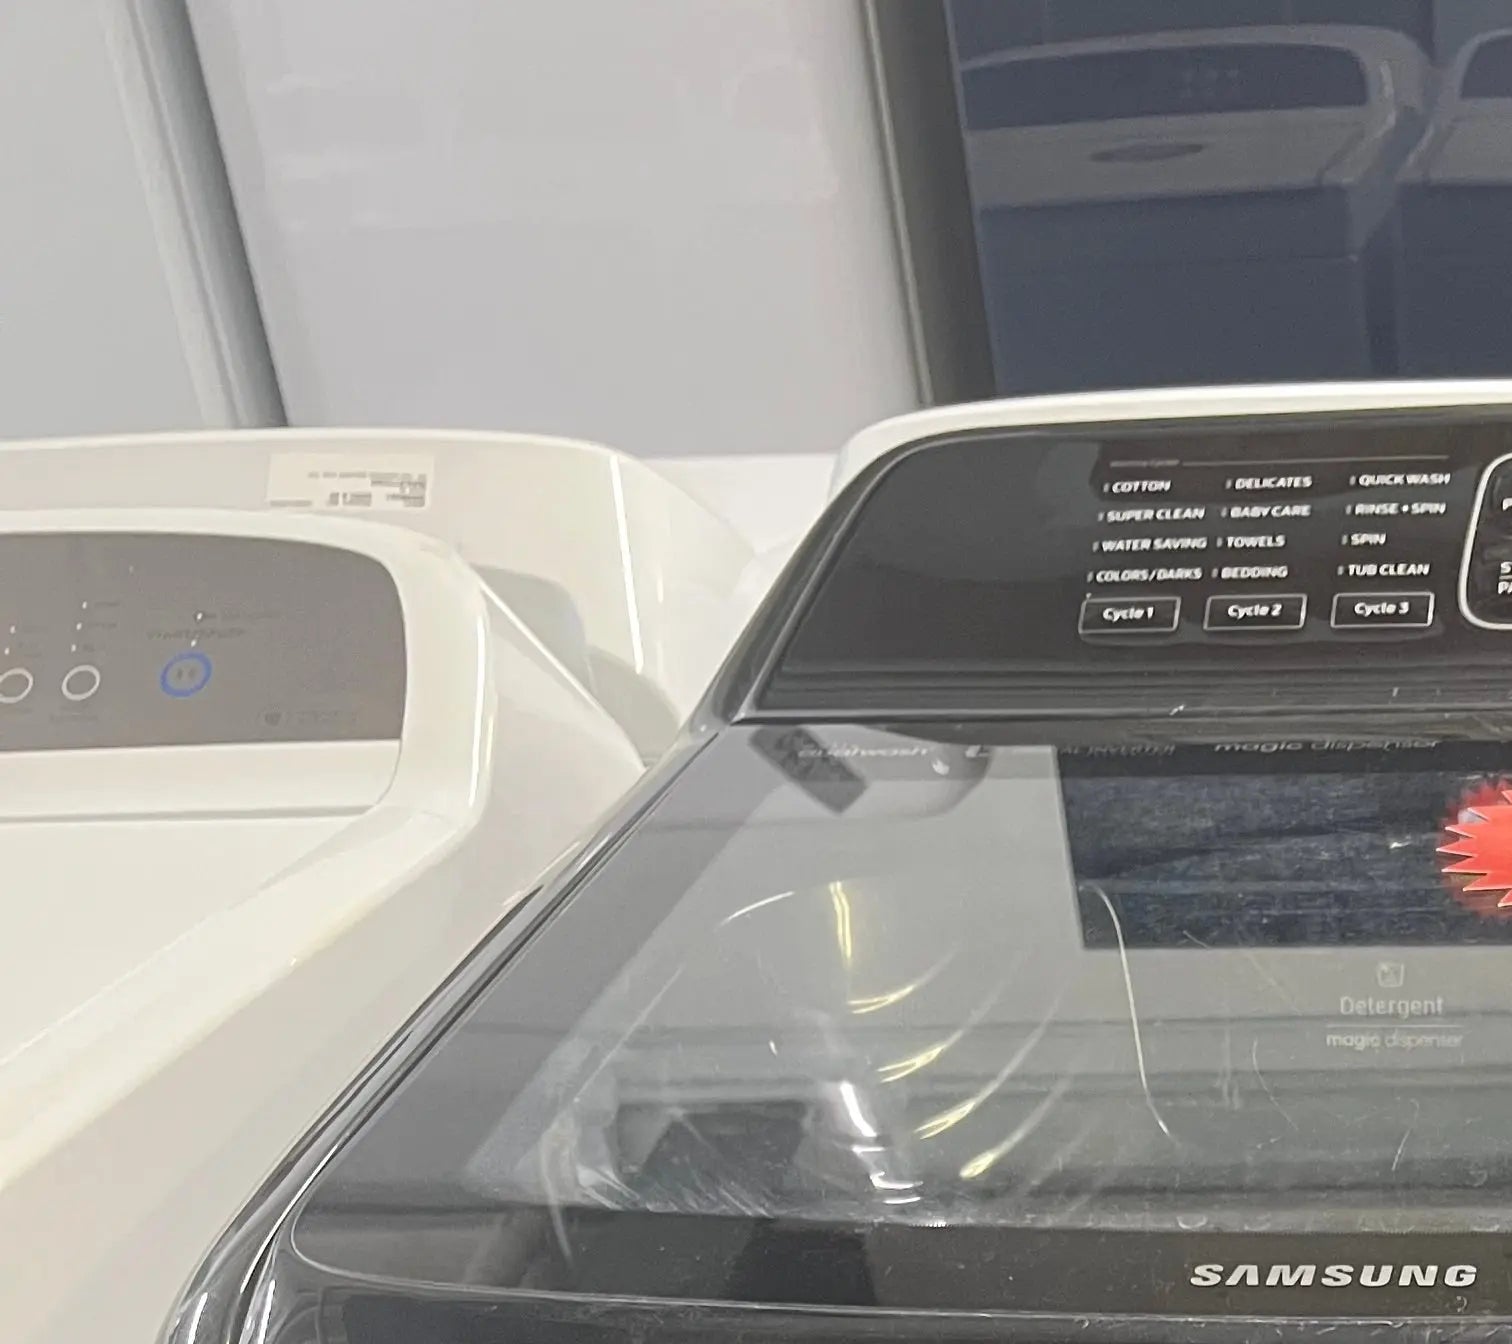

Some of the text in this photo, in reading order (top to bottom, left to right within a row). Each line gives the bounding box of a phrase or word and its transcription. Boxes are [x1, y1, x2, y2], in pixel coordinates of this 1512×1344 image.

[1112, 480, 1171, 493] COTTON
[1235, 476, 1312, 489] DELICATES
[1359, 473, 1451, 487] QUICK WASH
[1107, 508, 1205, 522] SUPER CLEAN
[1230, 505, 1312, 518] BABY CARE
[1355, 503, 1446, 516] RINSE SPIN
[1102, 537, 1207, 551] WATER SAVING
[1227, 535, 1286, 548] TOWELS
[1351, 533, 1386, 546] SPIN
[1221, 566, 1288, 579] BEDDING
[1348, 563, 1430, 576] TUB CLEAN
[1103, 606, 1154, 622] Cycle 1
[1228, 603, 1282, 619] Cycle 2
[1355, 601, 1409, 618] Cycle 3
[1340, 996, 1443, 1018] Detergent
[1190, 1264, 1478, 1287] SAMSUNG
